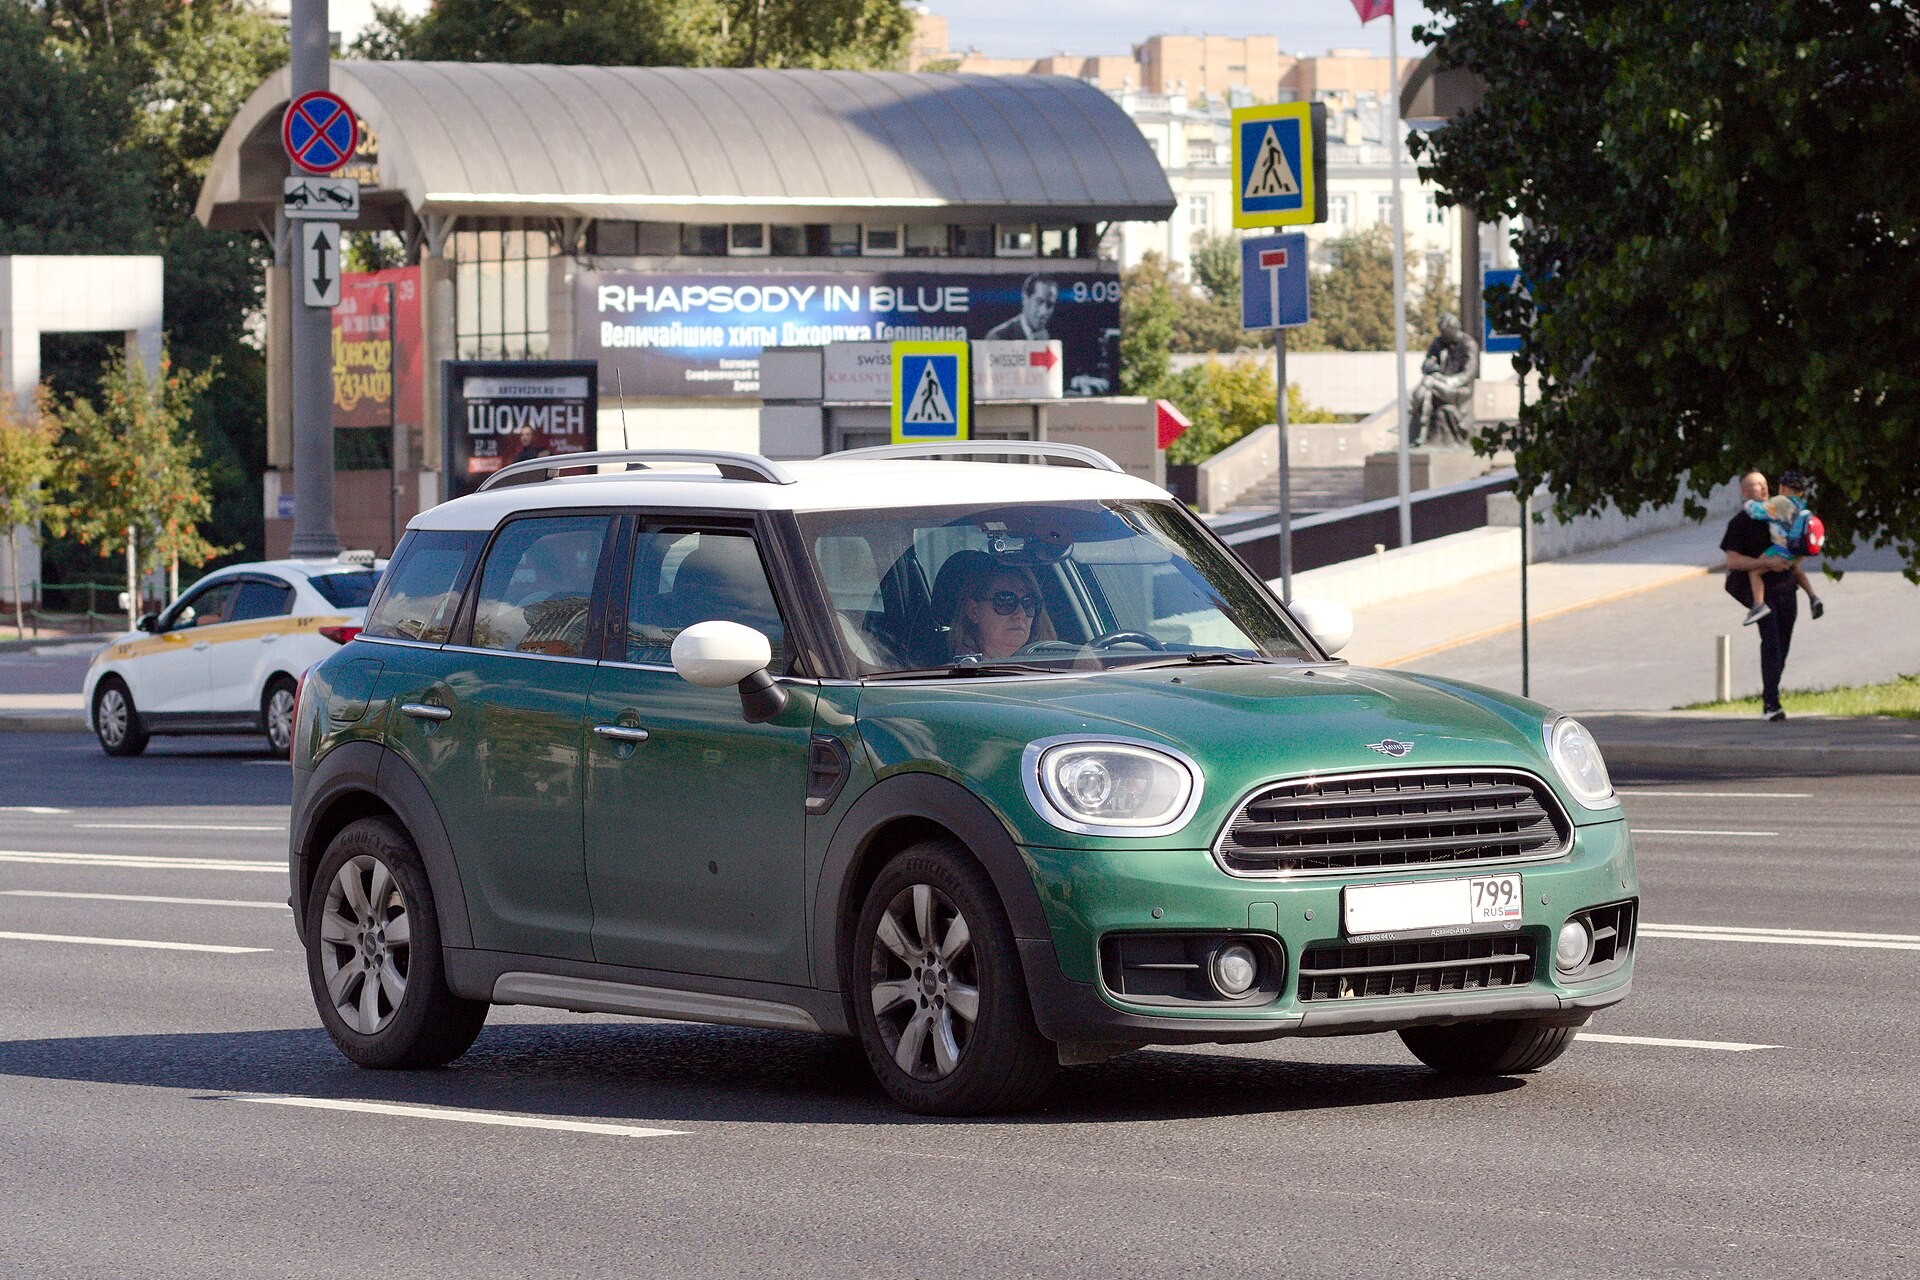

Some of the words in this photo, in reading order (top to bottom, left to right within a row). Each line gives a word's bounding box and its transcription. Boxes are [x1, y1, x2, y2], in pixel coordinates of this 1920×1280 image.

[597, 285, 816, 313] RHAPSODY
[823, 285, 861, 312] IN
[868, 286, 970, 313] BLUE
[600, 320, 725, 348] Величайшие
[728, 325, 777, 348] хиты
[467, 404, 585, 435] ШОУМЕН
[1472, 879, 1513, 908] 799
[1483, 907, 1504, 917] RUS
